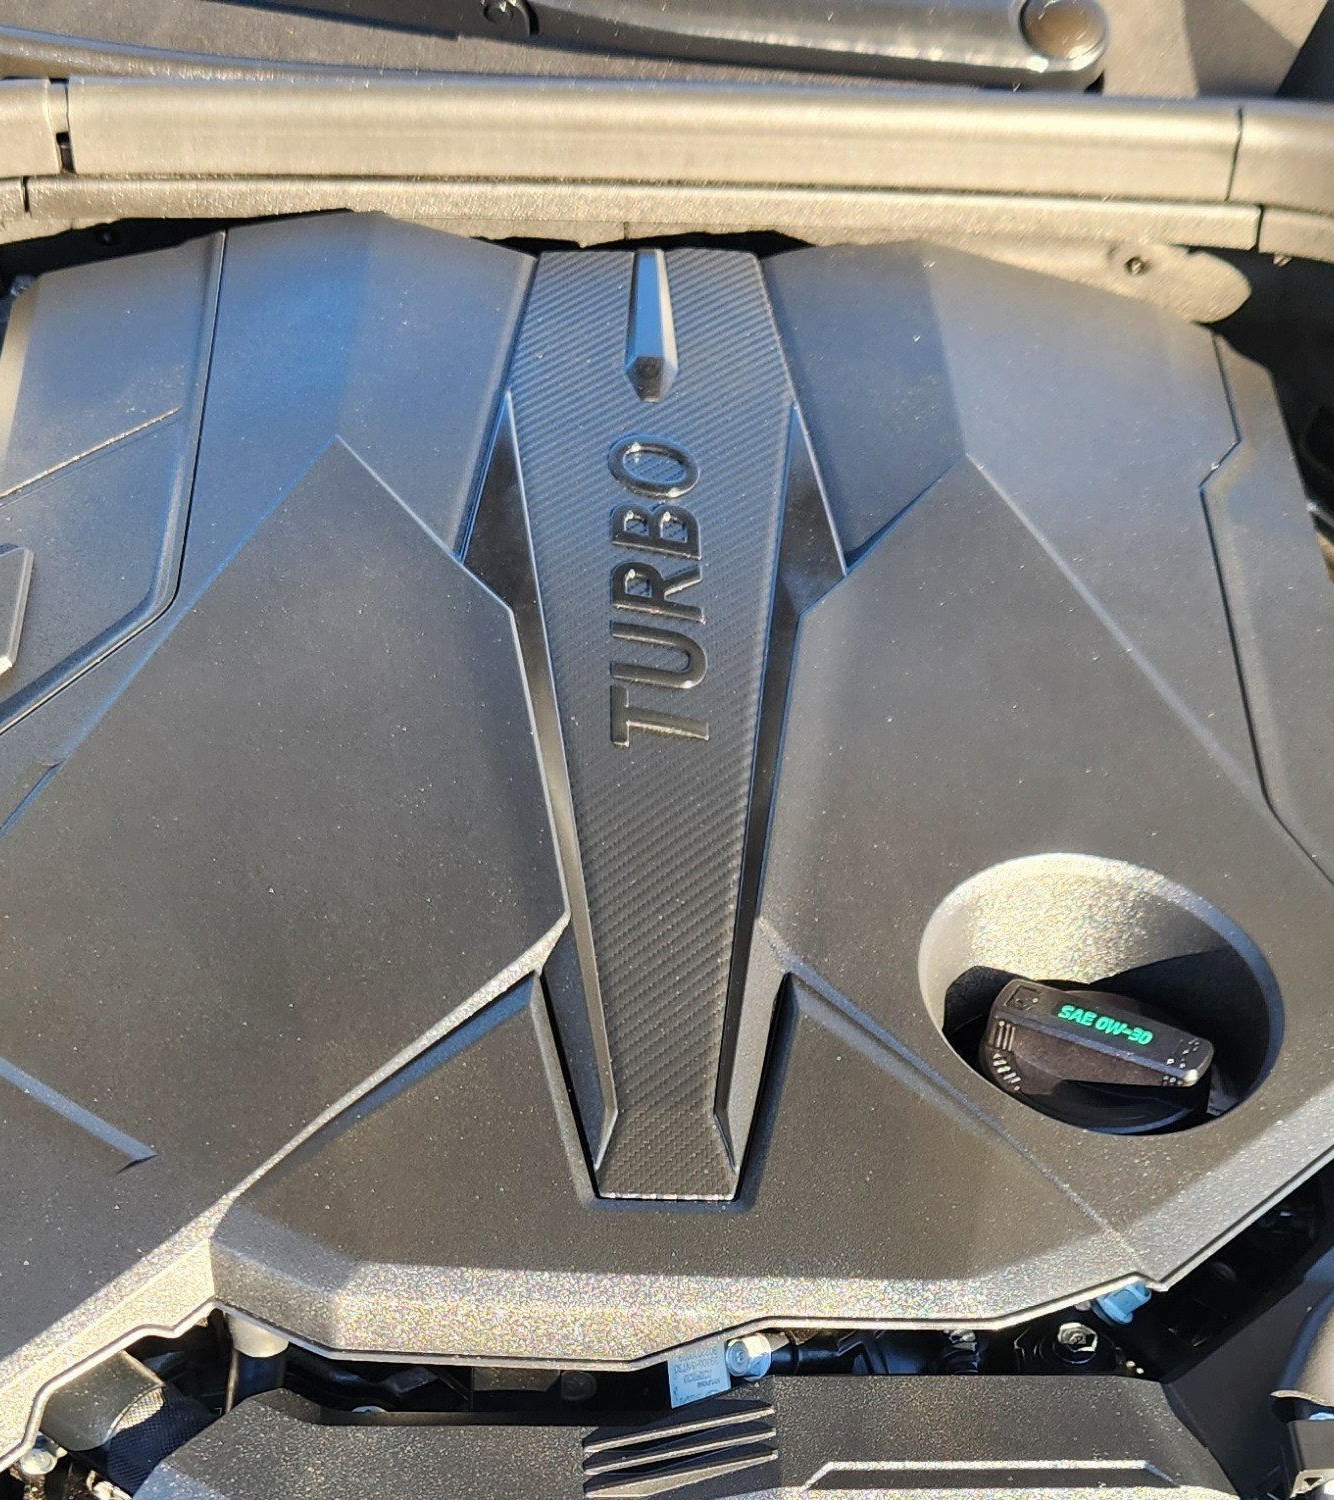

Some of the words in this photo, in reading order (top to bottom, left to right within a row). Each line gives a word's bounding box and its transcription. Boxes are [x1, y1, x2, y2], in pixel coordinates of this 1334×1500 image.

[607, 432, 709, 749] TURBO
[1057, 1004, 1097, 1027] SAE
[1095, 1015, 1154, 1046] 0W-30
